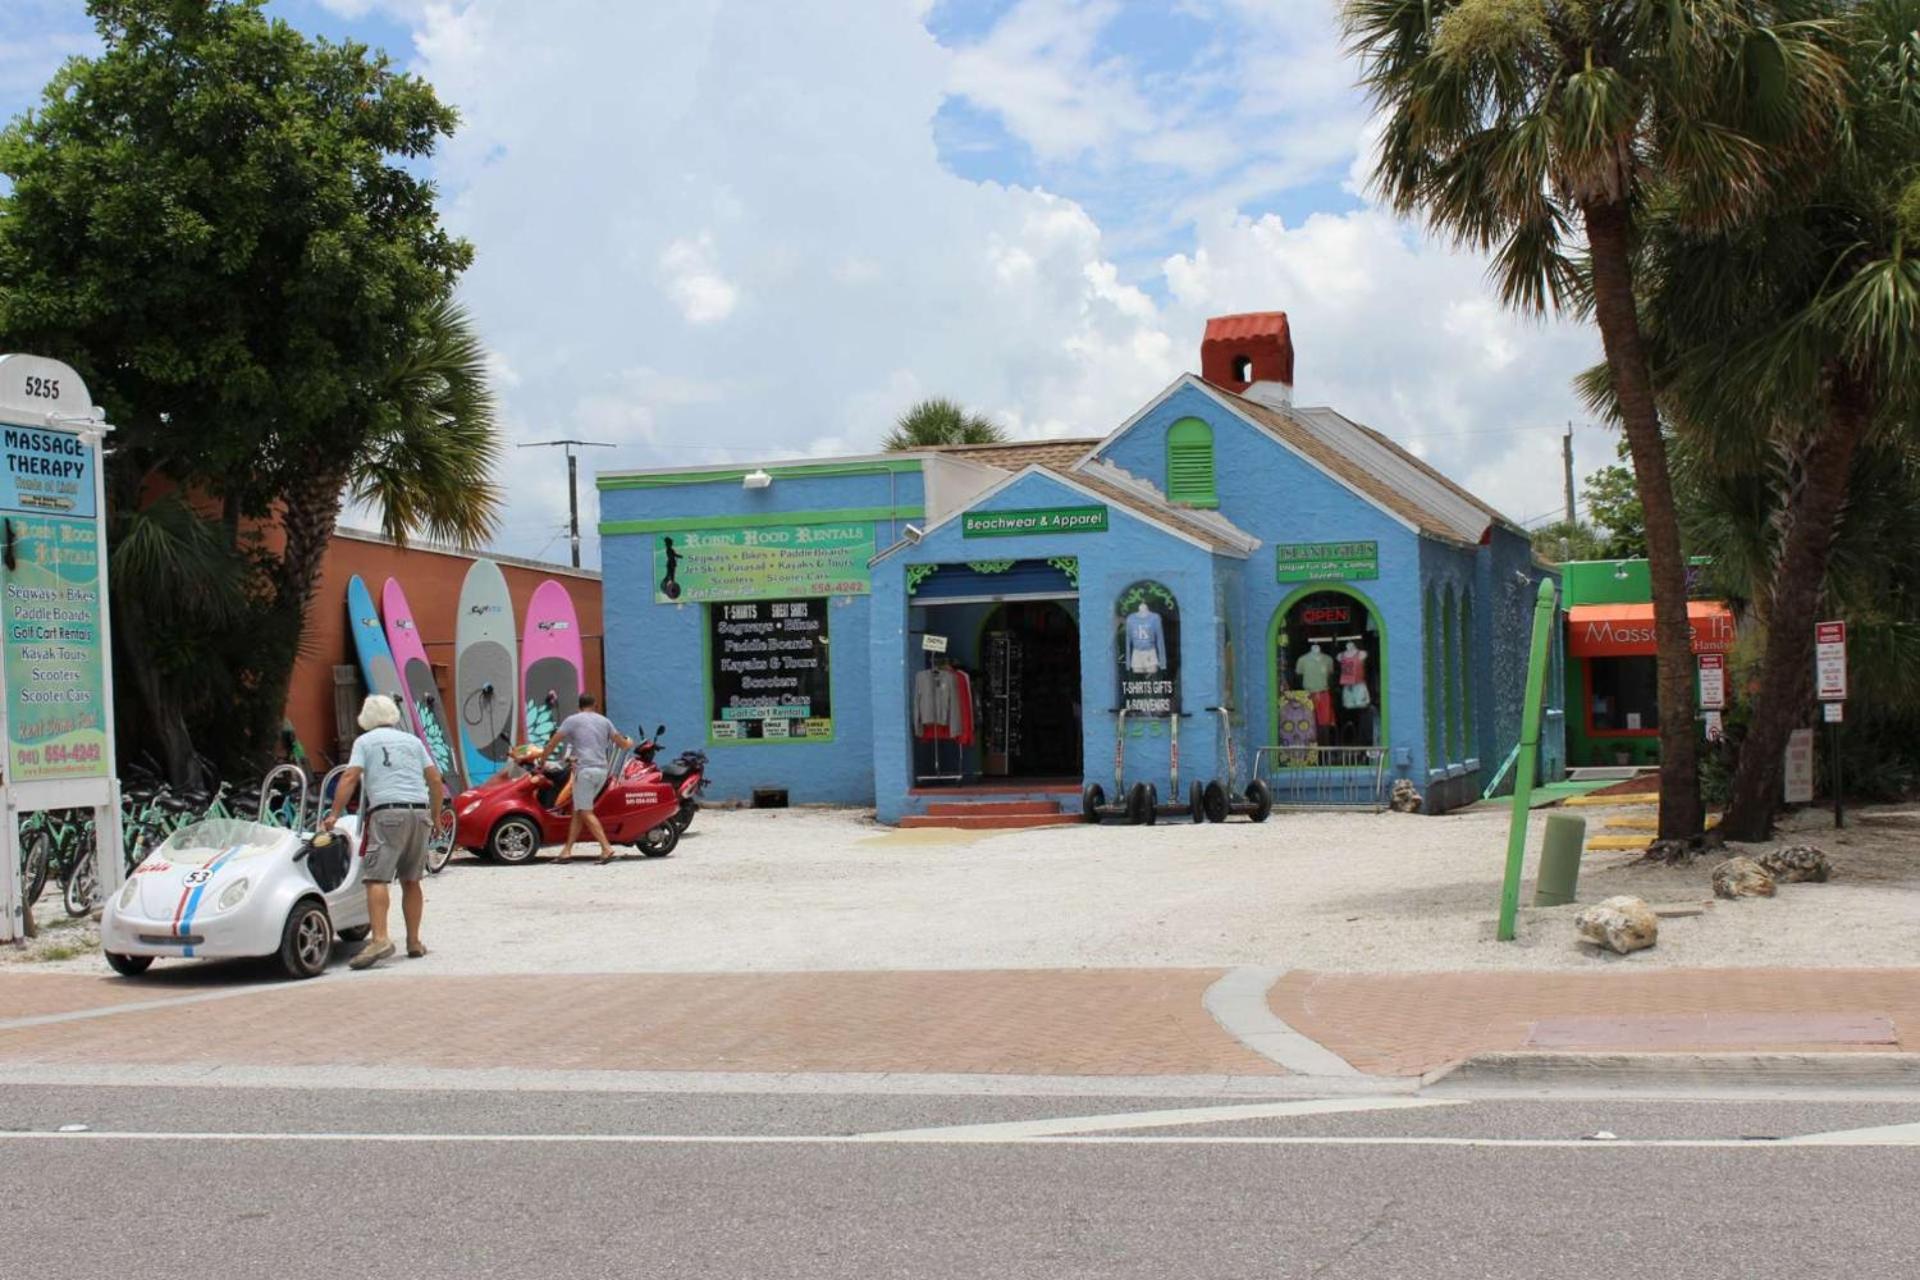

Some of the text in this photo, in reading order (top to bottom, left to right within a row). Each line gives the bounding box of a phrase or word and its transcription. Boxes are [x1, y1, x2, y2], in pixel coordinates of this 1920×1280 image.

[25, 375, 60, 400] 5255
[4, 430, 85, 457] MASSAGE
[6, 453, 85, 479] THERAPY
[966, 513, 1102, 531] Beachwear & Apparel
[8, 584, 96, 603] Segways Bikes
[15, 605, 91, 621] Paddle Boards
[724, 603, 758, 620] T-SHIRTS
[1303, 608, 1348, 622] OPEN
[13, 626, 92, 641] Golf Cart Rentals
[718, 619, 819, 635] Segways Bikes
[1585, 620, 1696, 643] Masse
[724, 637, 813, 652] Paddle Boards
[22, 646, 87, 661] Kayak Tours
[721, 656, 818, 673] Kayaks & Tours
[32, 667, 80, 682] Scooters
[741, 676, 798, 689] Scooters
[1122, 680, 1173, 695] T-SHIRTS GIFTS
[22, 688, 90, 702] Scooter Cars
[781, 693, 811, 705] Cars
[186, 871, 210, 883] 53
